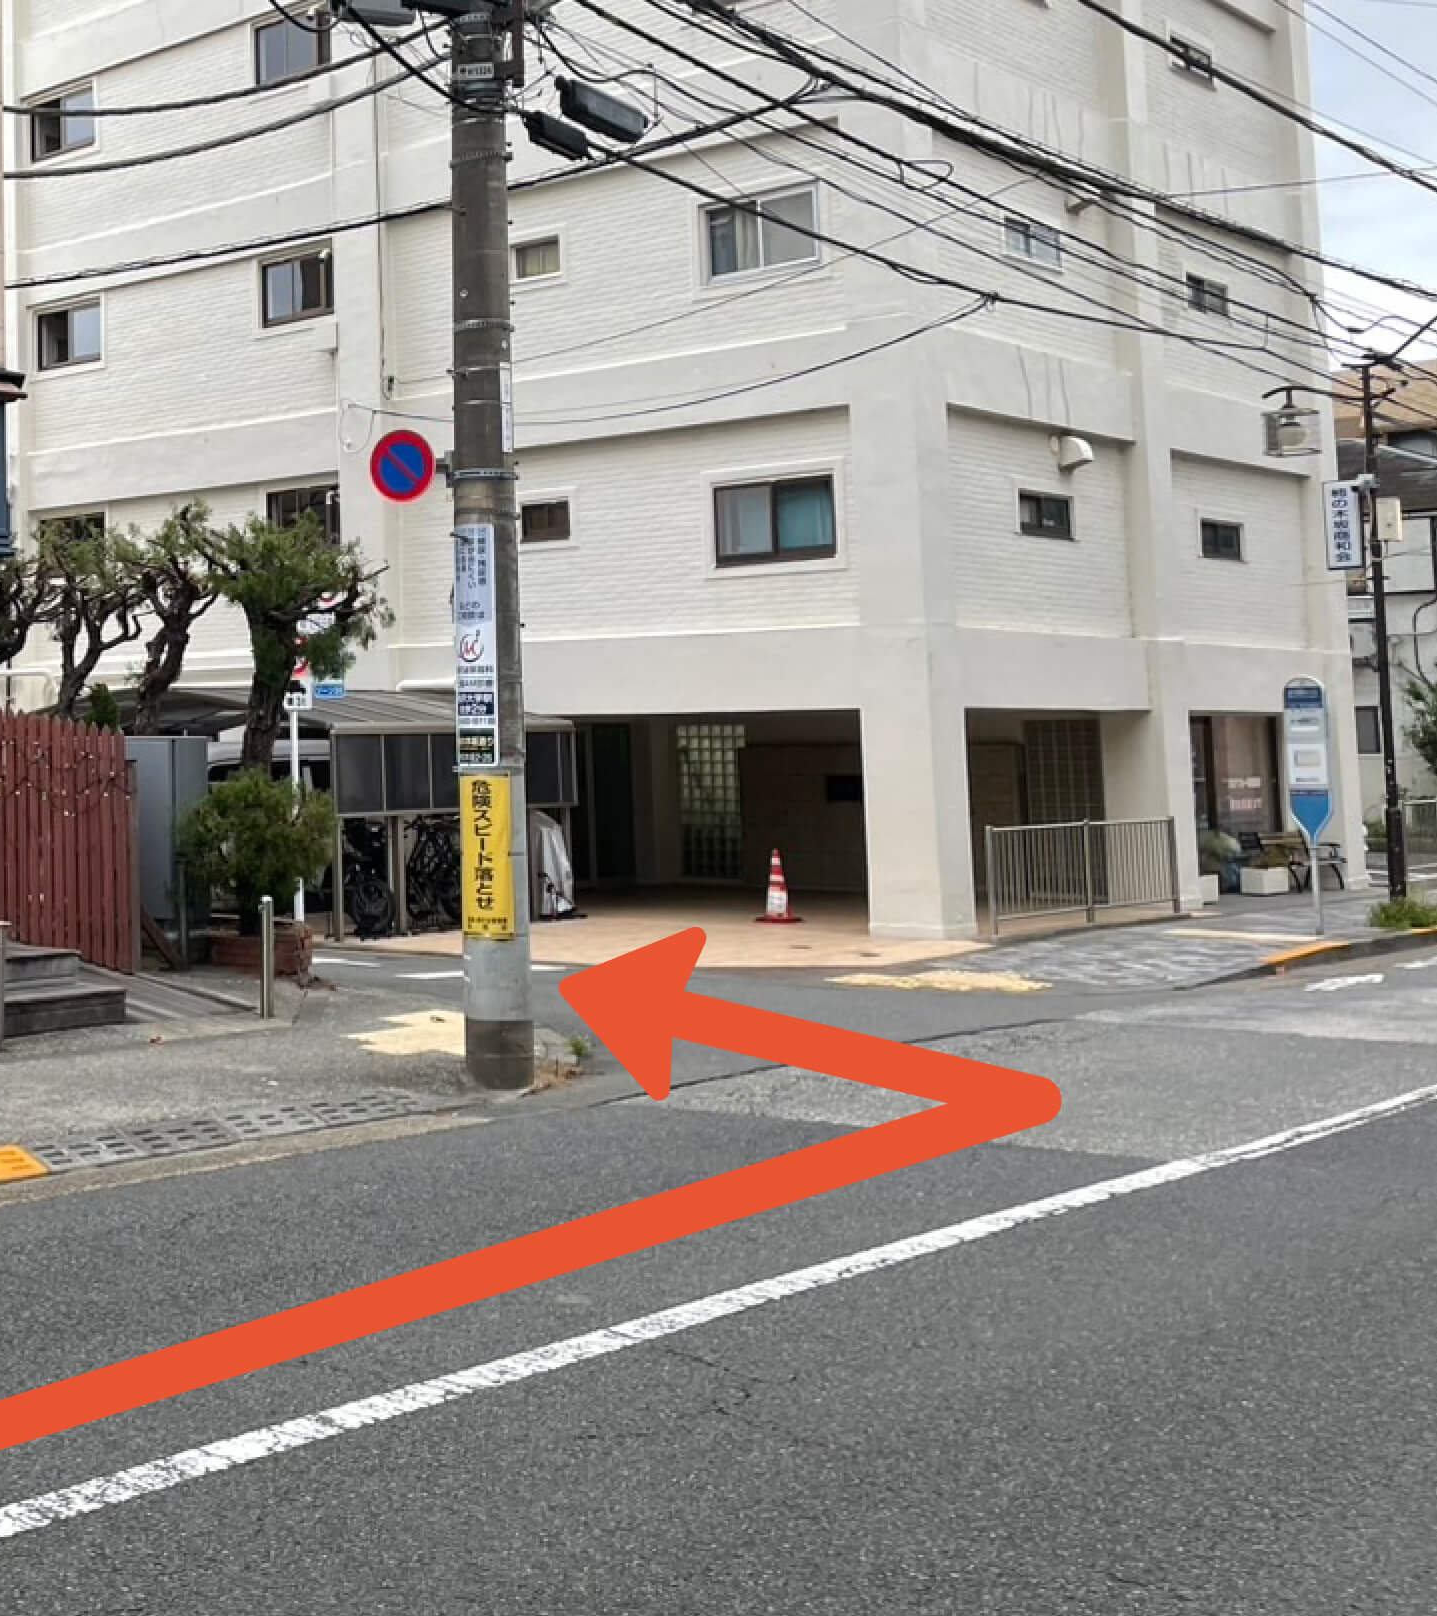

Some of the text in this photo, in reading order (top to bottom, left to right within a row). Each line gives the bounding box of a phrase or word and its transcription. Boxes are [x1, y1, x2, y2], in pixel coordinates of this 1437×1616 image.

[471, 780, 495, 910] 危険スピード落とせ
